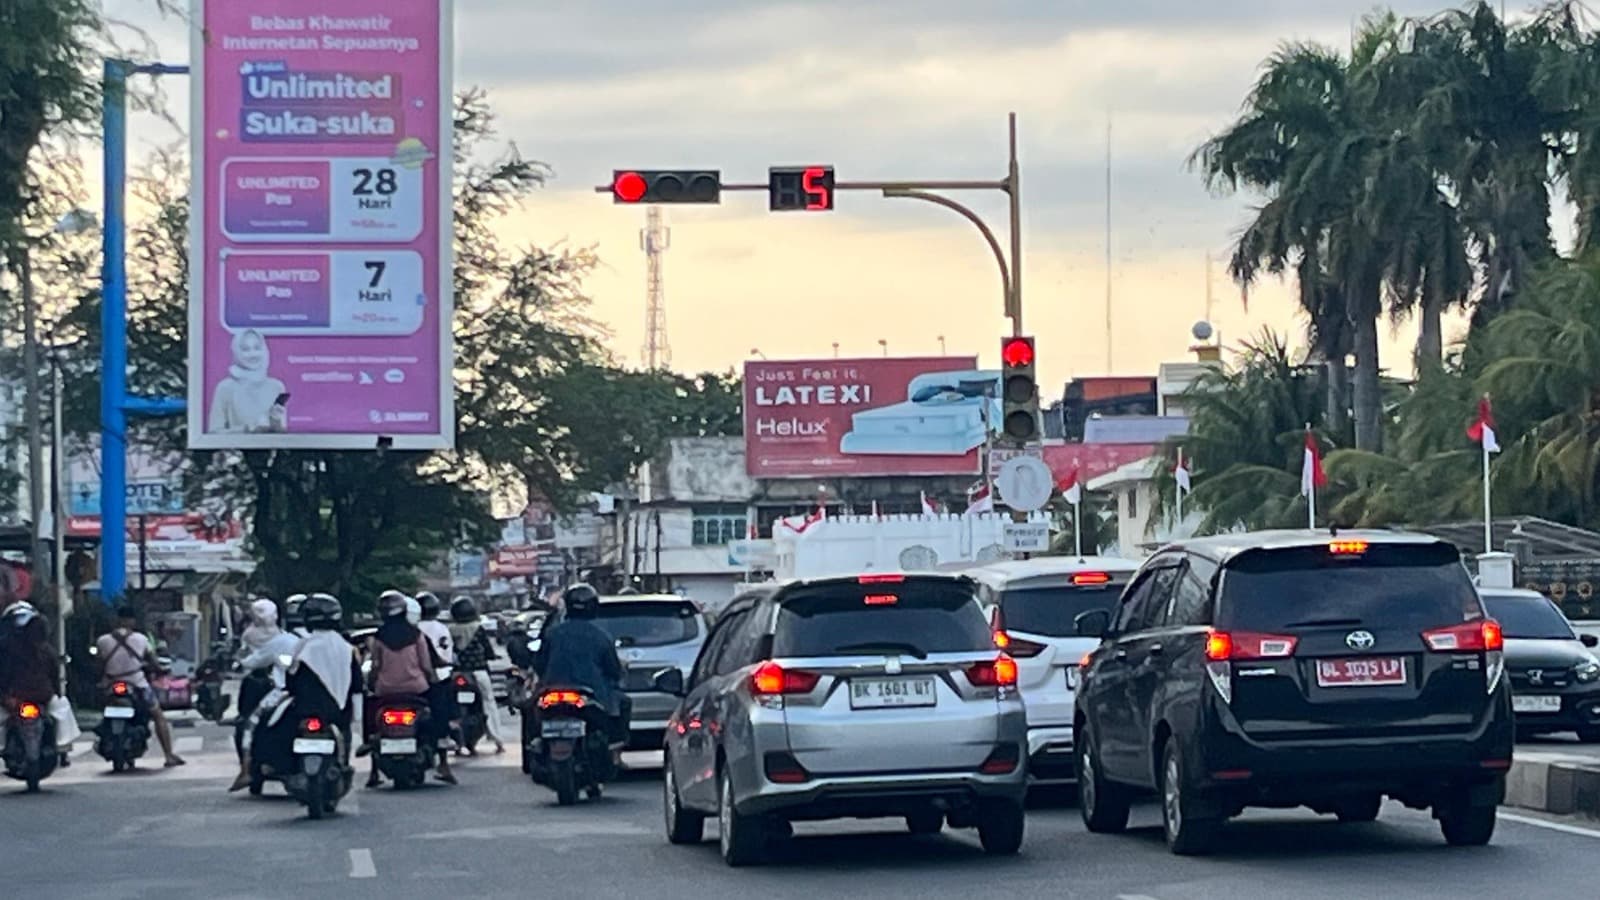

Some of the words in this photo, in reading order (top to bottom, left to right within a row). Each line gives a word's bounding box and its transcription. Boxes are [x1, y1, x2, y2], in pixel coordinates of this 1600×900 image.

[250, 16, 306, 31] Bebas
[309, 14, 392, 31] Khawatir
[223, 36, 319, 50] Internetan
[322, 36, 419, 53] Sepuasnya
[247, 73, 393, 99] Unlimited
[246, 110, 395, 135] Suka-suka
[237, 176, 321, 190] UNLIMITED
[352, 168, 398, 196] 28
[802, 166, 828, 211] 5
[358, 196, 392, 210] Hari
[238, 269, 321, 283] UNLIMITED
[364, 260, 387, 288] 7
[358, 288, 392, 303] Hari
[755, 368, 796, 382] Just
[802, 367, 838, 381] Feel
[755, 384, 871, 406] LATEX!
[755, 416, 828, 437] Helux
